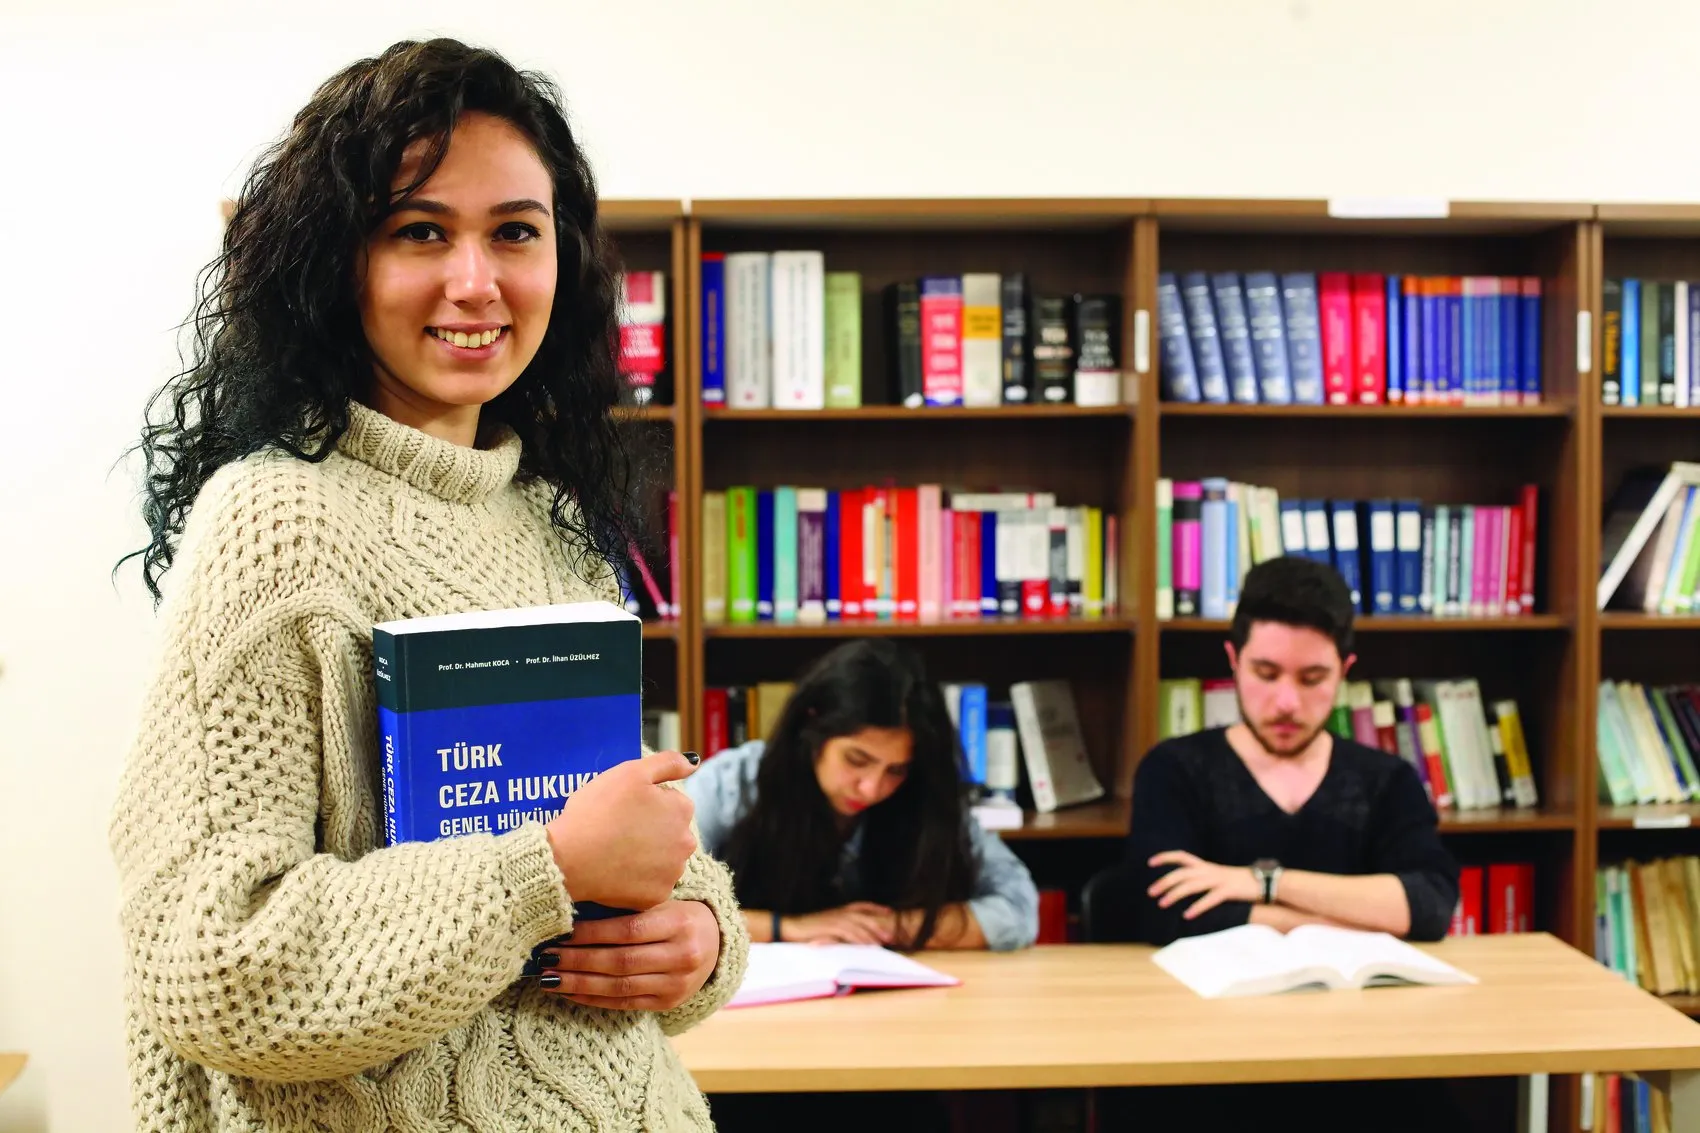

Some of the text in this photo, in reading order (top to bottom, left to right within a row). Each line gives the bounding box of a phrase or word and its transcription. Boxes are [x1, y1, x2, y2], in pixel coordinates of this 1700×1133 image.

[438, 663, 454, 671] Prof.
[465, 661, 491, 669] Mahmut
[492, 659, 510, 667] KOCA
[569, 653, 600, 661] ÜZÜLMEZ
[385, 734, 394, 776] TÜRK
[436, 741, 503, 772] TÜRK
[387, 777, 396, 814] CEZA
[439, 771, 599, 809] CEZA HUKUK
[439, 807, 565, 836] GENEL HÜKÜM
